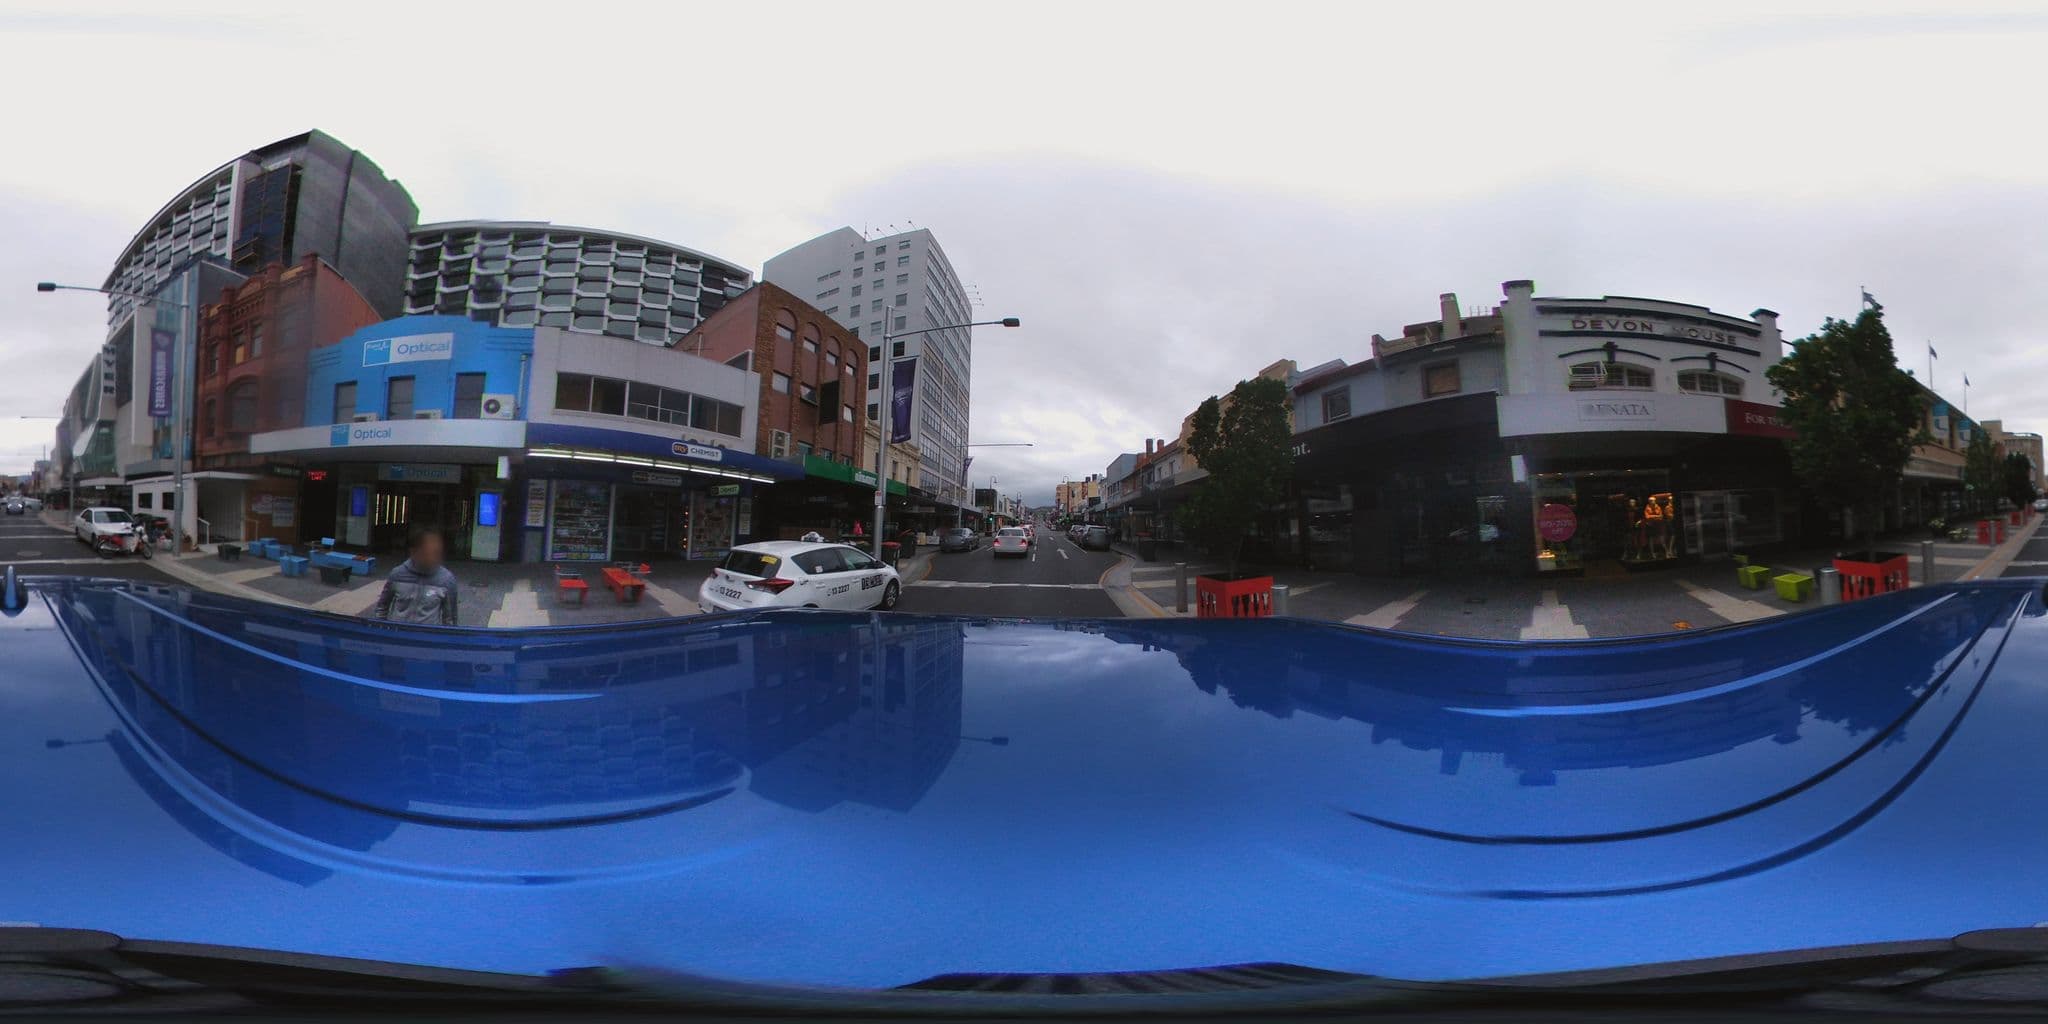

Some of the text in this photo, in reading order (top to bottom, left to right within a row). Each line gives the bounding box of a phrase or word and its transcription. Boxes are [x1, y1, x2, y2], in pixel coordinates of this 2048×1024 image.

[1571, 319, 1653, 333] DEVON
[397, 340, 450, 356] Optical
[354, 427, 392, 440] Optical
[690, 448, 719, 457] CHEMIST
[726, 588, 742, 600] 2227
[838, 584, 850, 594] 2227
